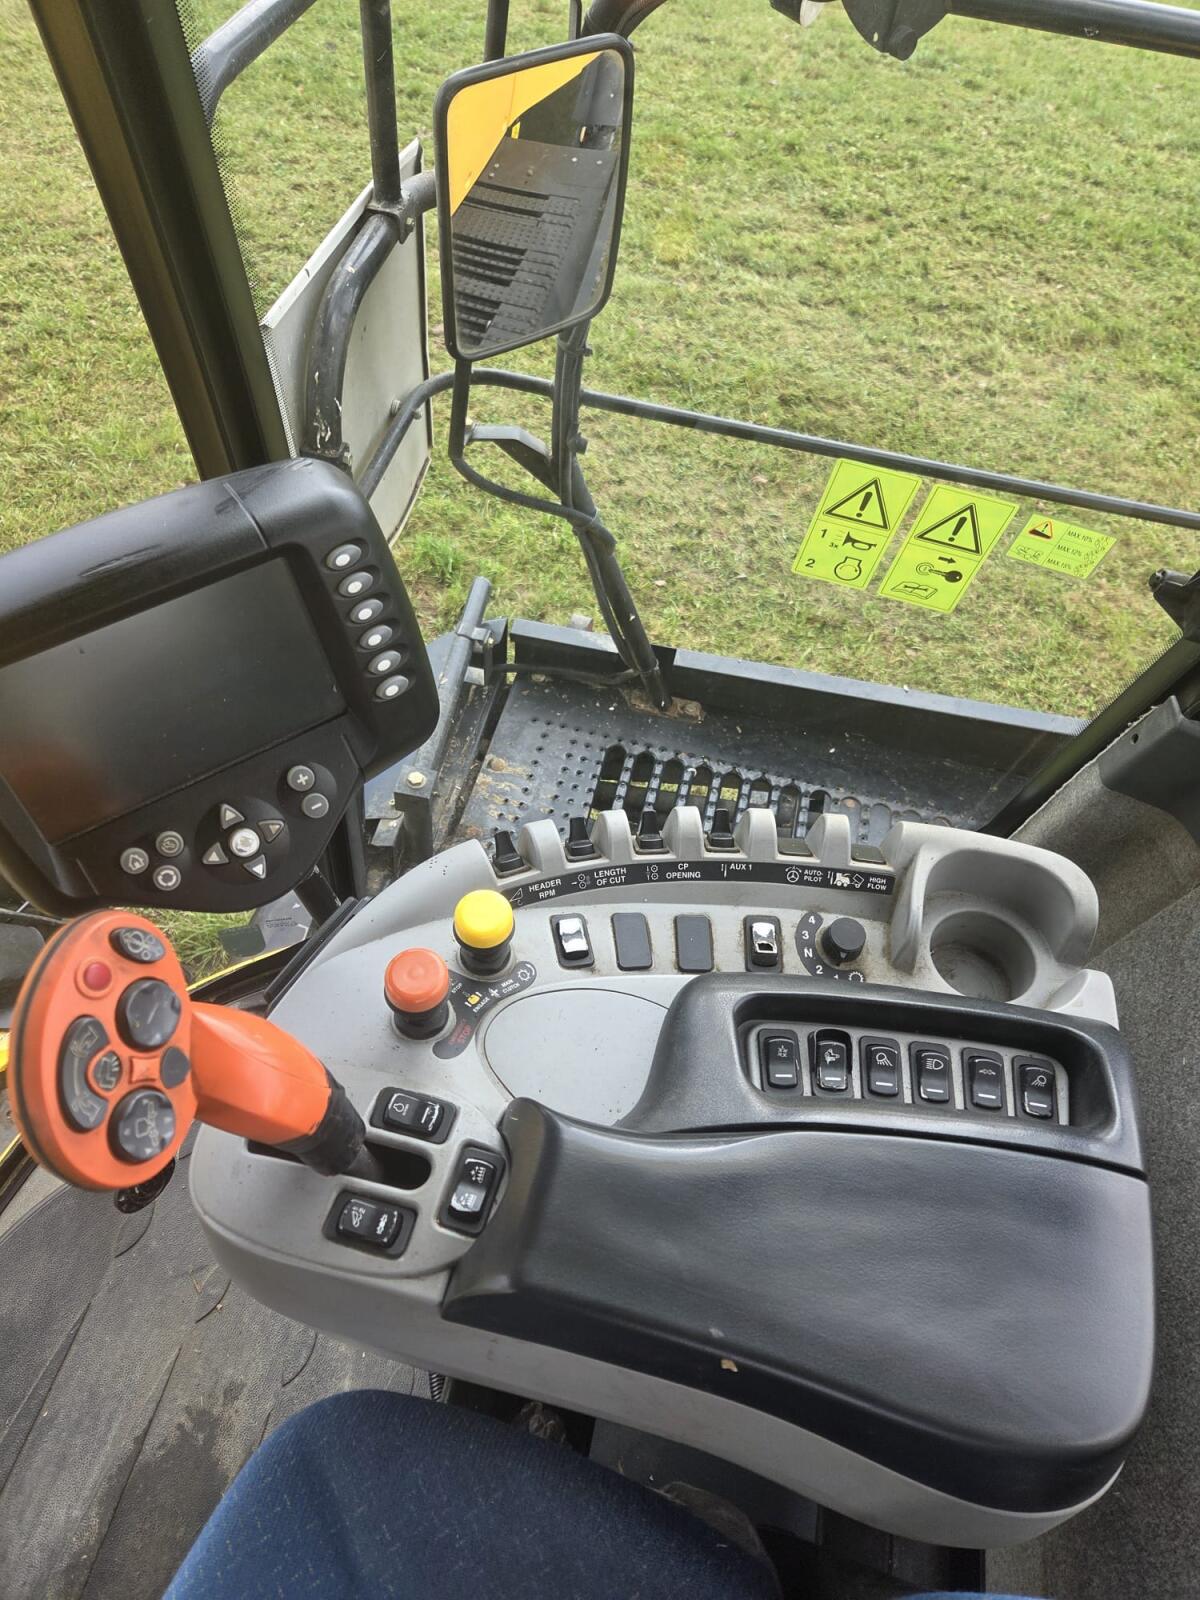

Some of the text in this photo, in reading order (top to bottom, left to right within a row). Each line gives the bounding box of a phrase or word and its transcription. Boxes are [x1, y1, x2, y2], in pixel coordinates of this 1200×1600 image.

[821, 528, 828, 538] 1
[1067, 530, 1081, 539] MAX
[1057, 544, 1070, 552] MAX
[805, 558, 816, 568] 2
[1047, 558, 1060, 566] MAX
[594, 867, 627, 879] LENGTH
[665, 871, 701, 879] OPENING
[596, 875, 626, 886] OF CUT
[803, 875, 822, 883] PILOT
[869, 876, 887, 885] HIGH
[529, 878, 562, 893] HEADER
[867, 883, 887, 891] FLOW
[539, 888, 556, 899] RPM
[808, 915, 816, 925] 4
[801, 930, 810, 940] 3
[803, 947, 813, 958] N
[815, 965, 823, 975] 2
[451, 982, 463, 994] STOP
